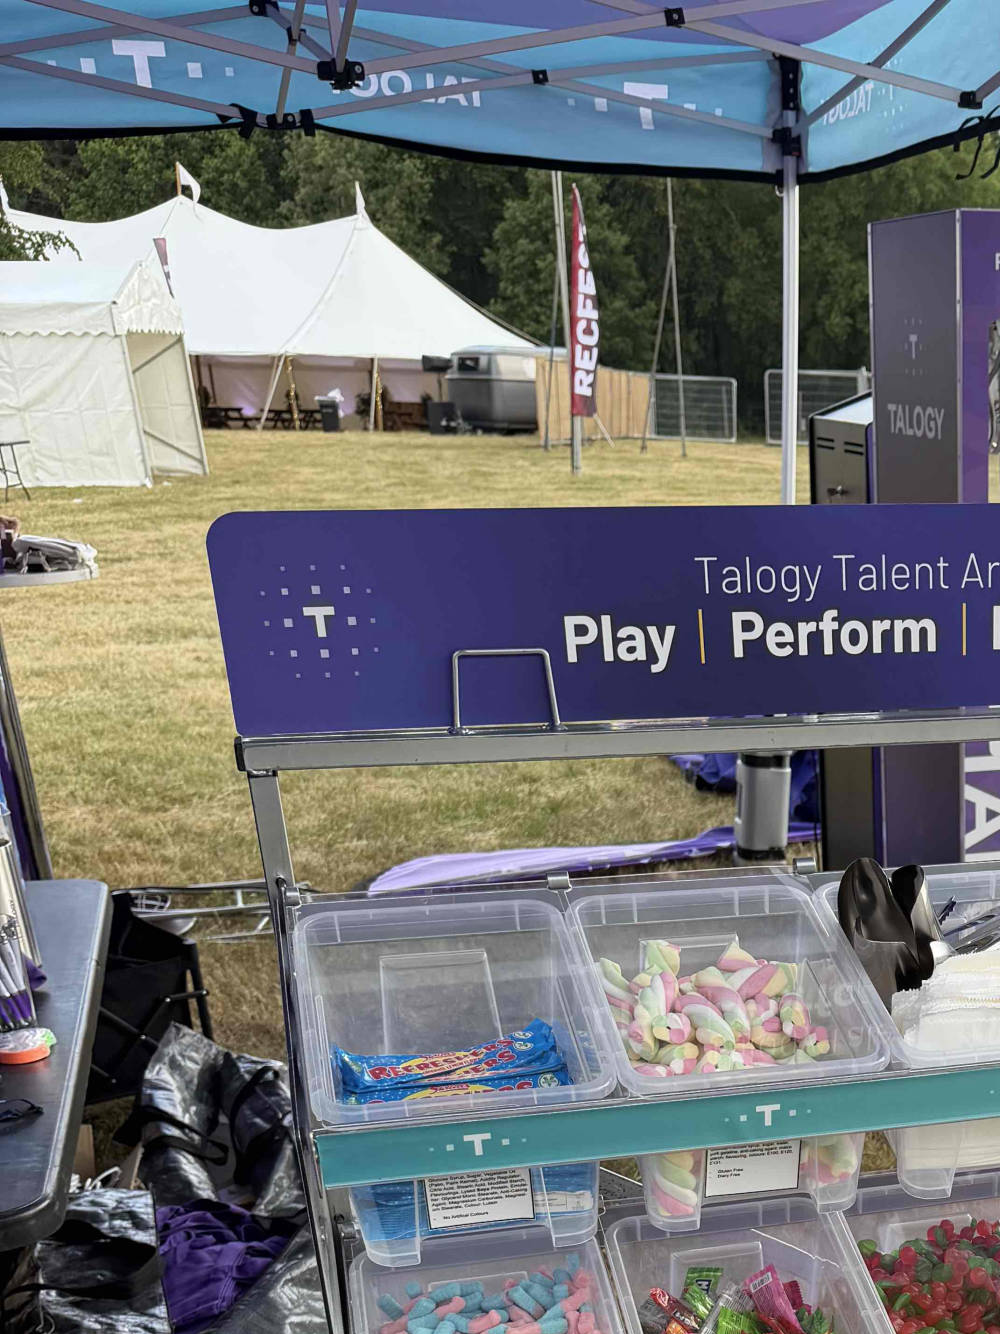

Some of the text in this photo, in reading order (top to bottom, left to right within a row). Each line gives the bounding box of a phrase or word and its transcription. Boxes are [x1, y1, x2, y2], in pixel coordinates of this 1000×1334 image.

[112, 39, 166, 88] T
[623, 82, 669, 130] T
[908, 333, 919, 359] T
[887, 403, 945, 440] TALOGY
[695, 555, 822, 602] Talogy
[833, 553, 949, 592] Talent
[303, 606, 335, 638] T
[563, 613, 676, 673] Play
[731, 609, 938, 660] Perform
[755, 1104, 780, 1126] T
[463, 1132, 492, 1156] T
